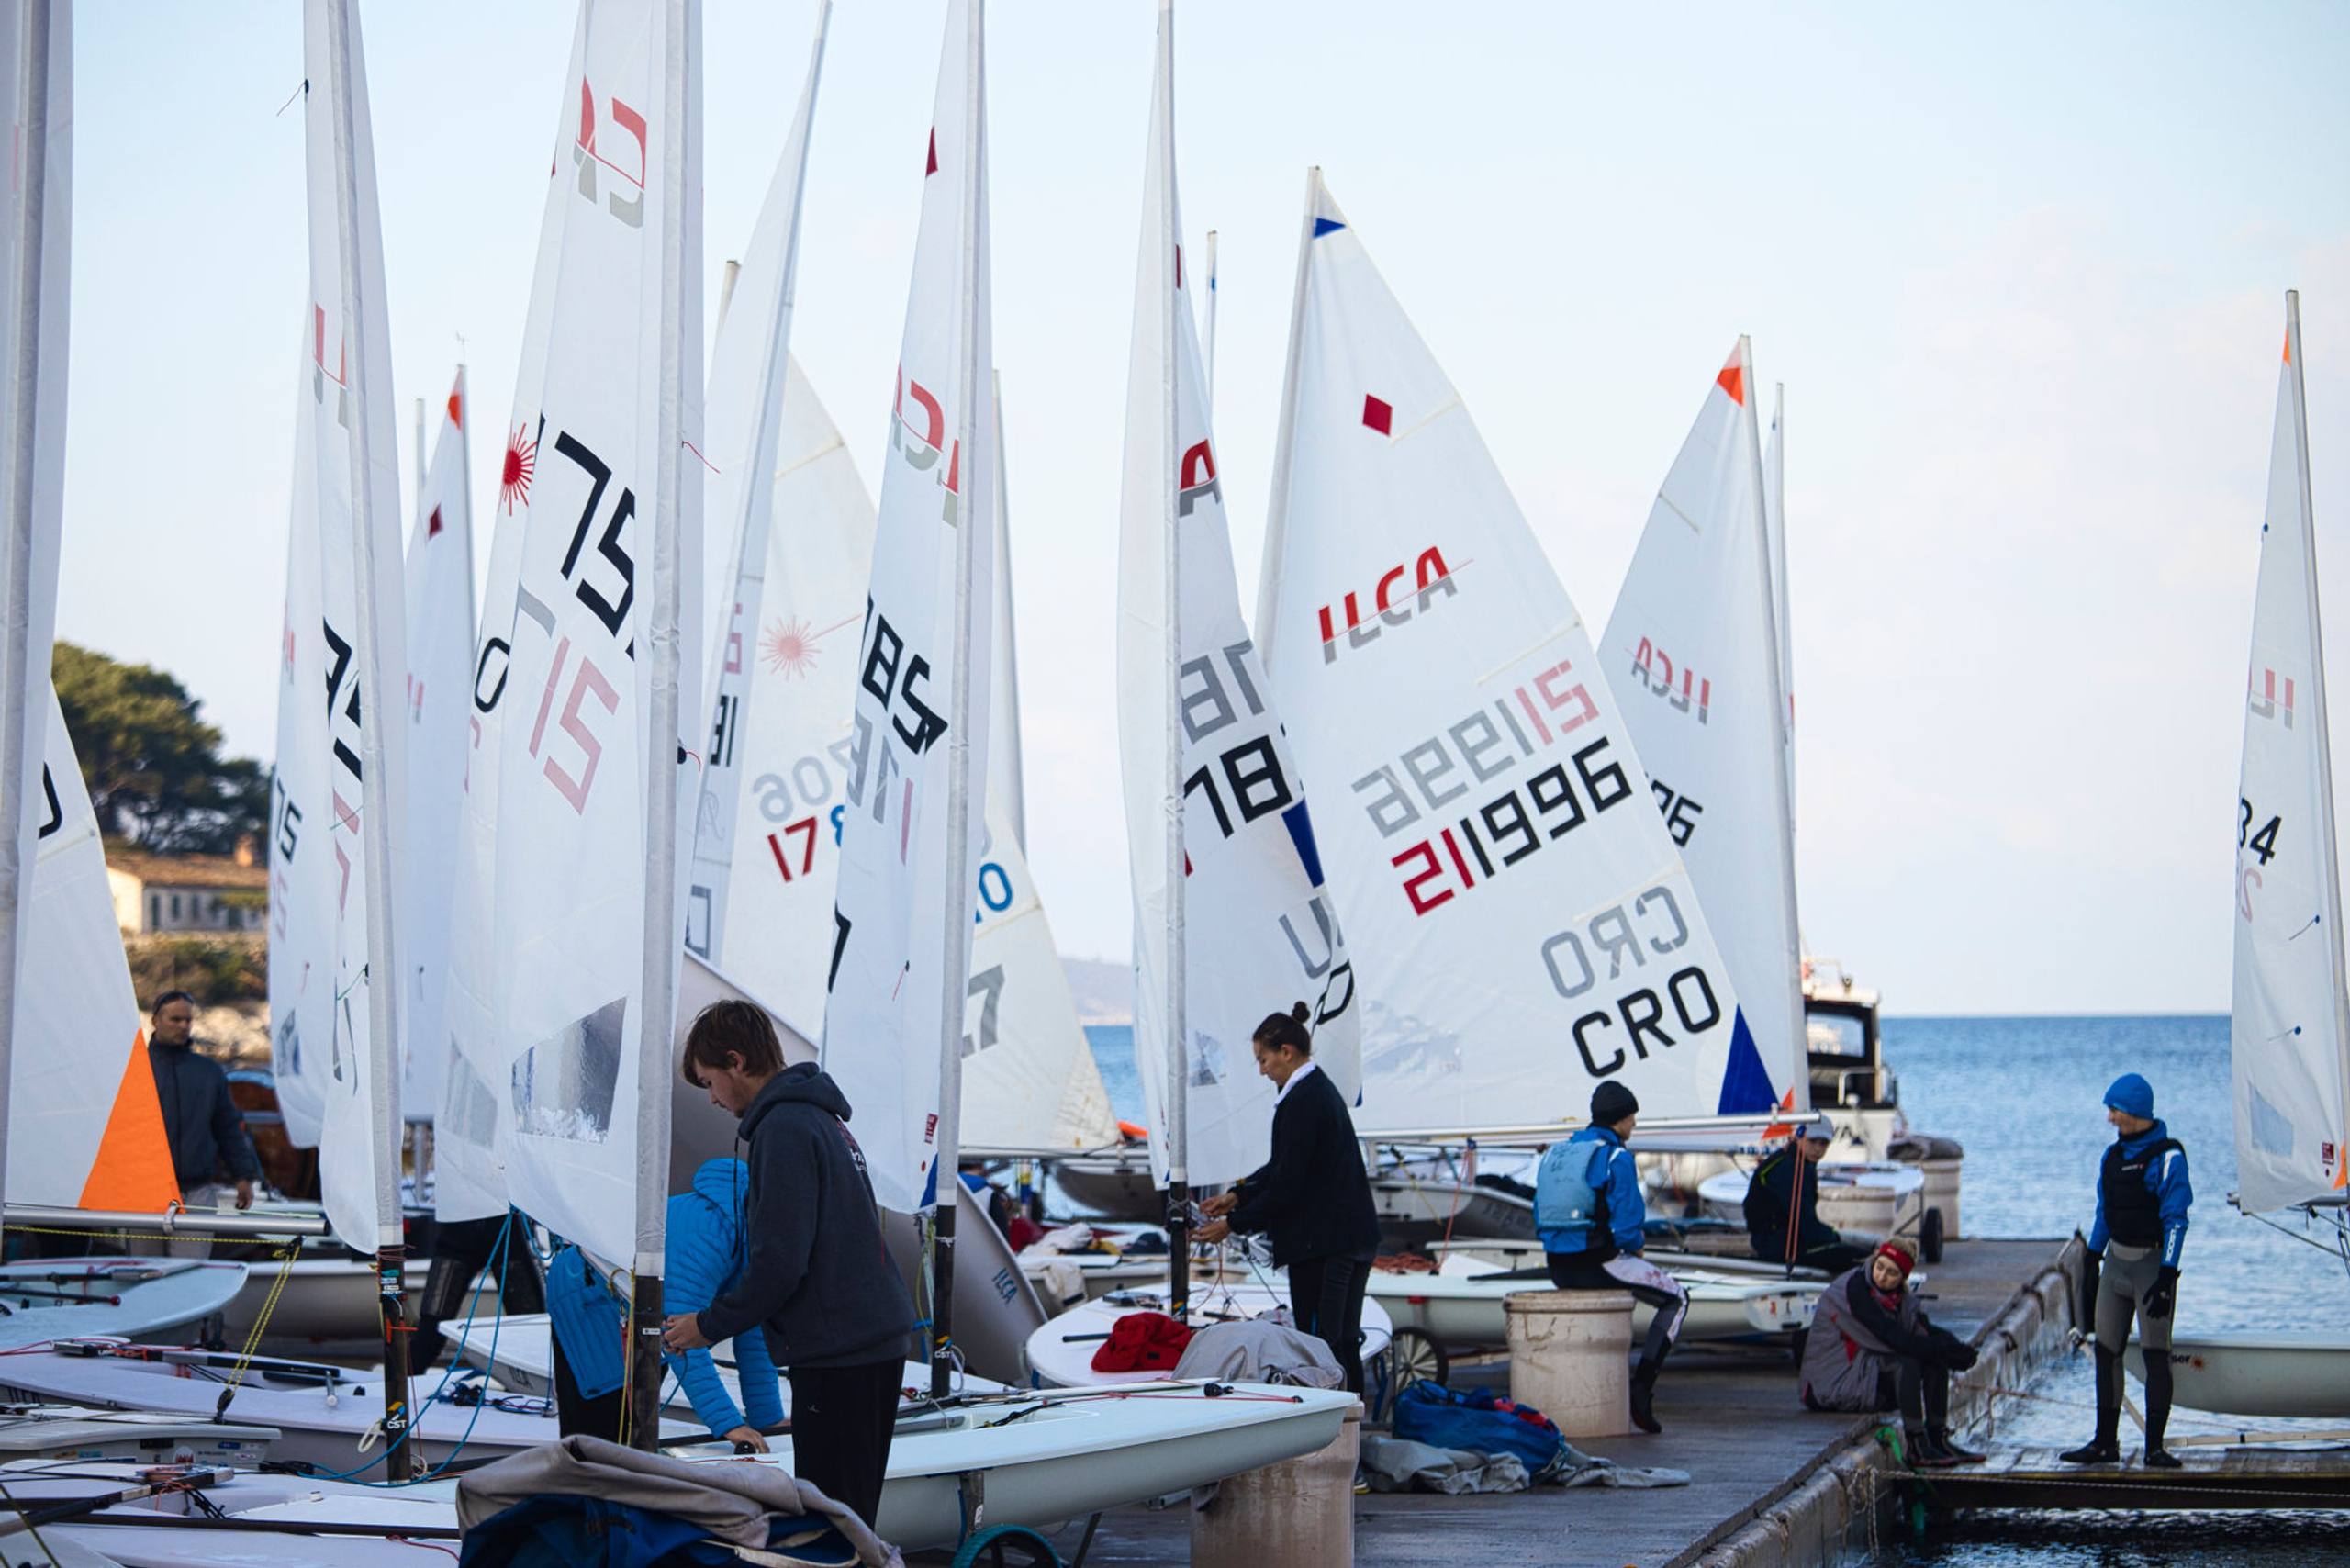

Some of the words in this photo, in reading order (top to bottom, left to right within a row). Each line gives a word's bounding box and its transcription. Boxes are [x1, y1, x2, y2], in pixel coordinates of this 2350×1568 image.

[539, 409, 635, 663] 75
[1317, 545, 1474, 666] ILCA
[1391, 734, 1633, 917] 211996
[1644, 771, 1704, 849] 96
[1571, 964, 1722, 1079] CRO
[386, 1418, 408, 1430] CST
